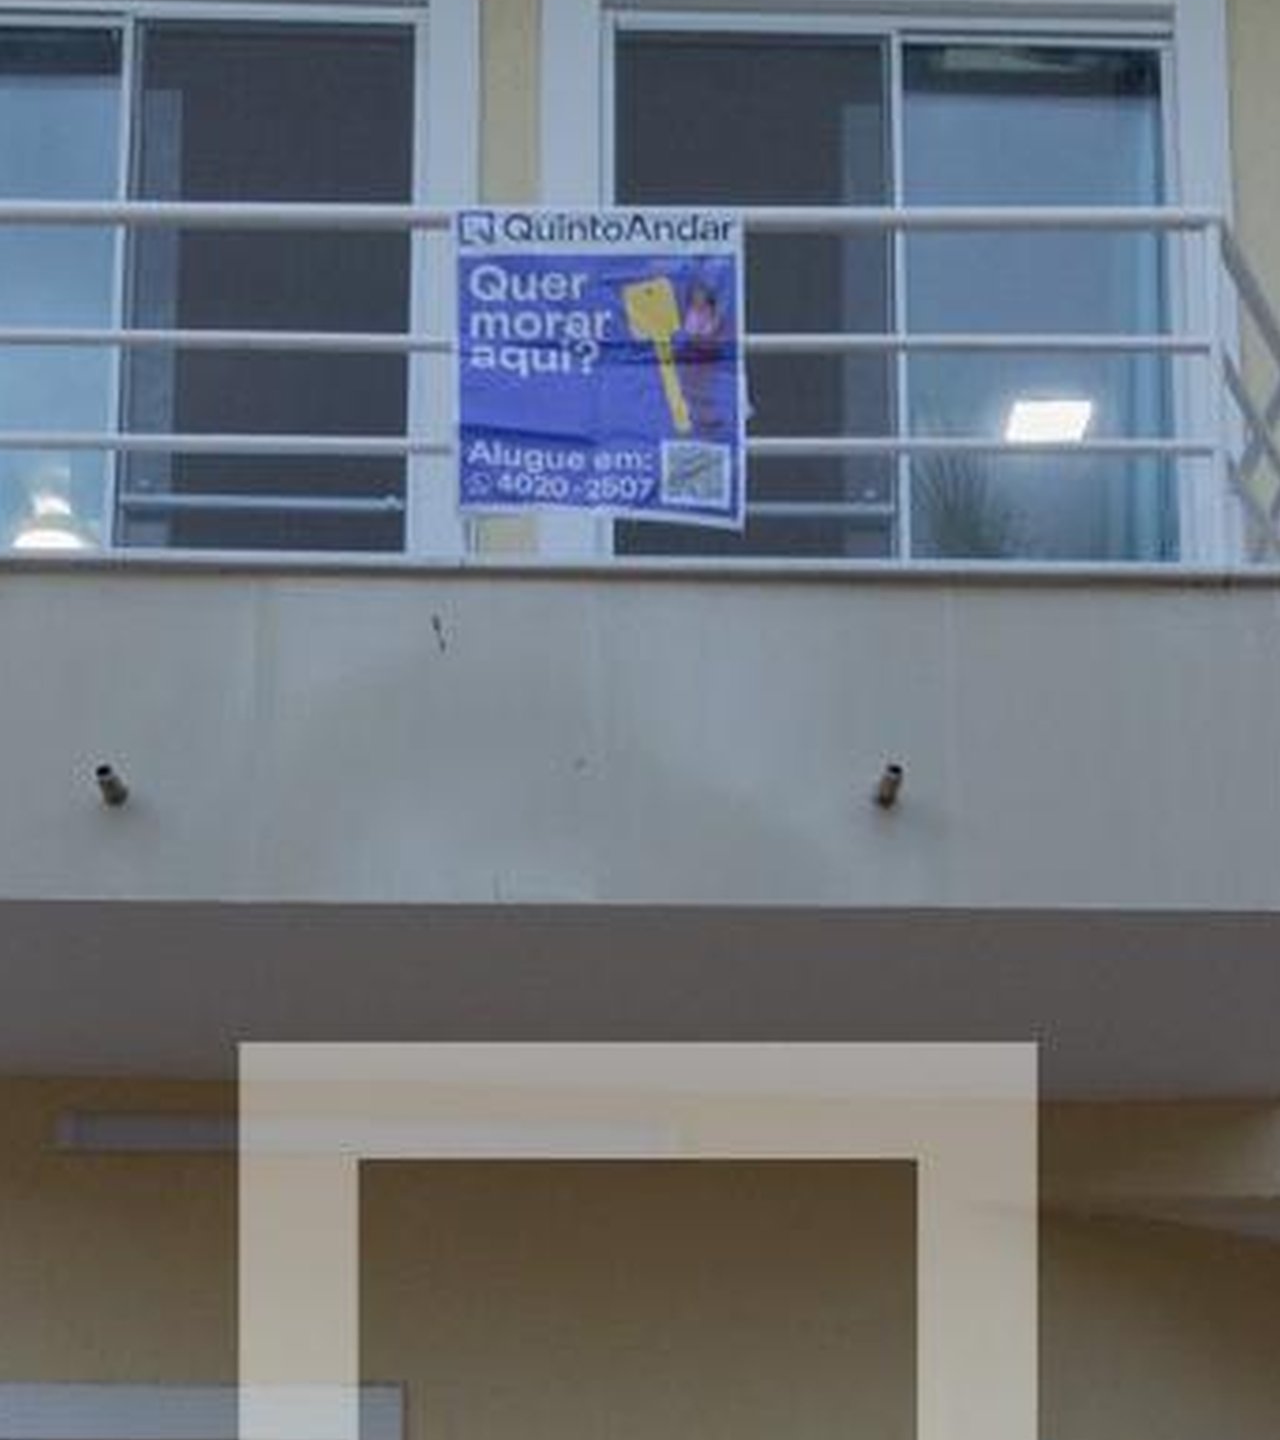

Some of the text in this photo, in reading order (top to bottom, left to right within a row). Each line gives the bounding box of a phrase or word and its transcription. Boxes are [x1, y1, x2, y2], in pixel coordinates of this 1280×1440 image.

[504, 212, 731, 242] QuintoAndar
[470, 264, 588, 301] Quer
[470, 309, 611, 340] morar
[470, 338, 599, 378] aqui?
[468, 440, 654, 474] Alugue em:
